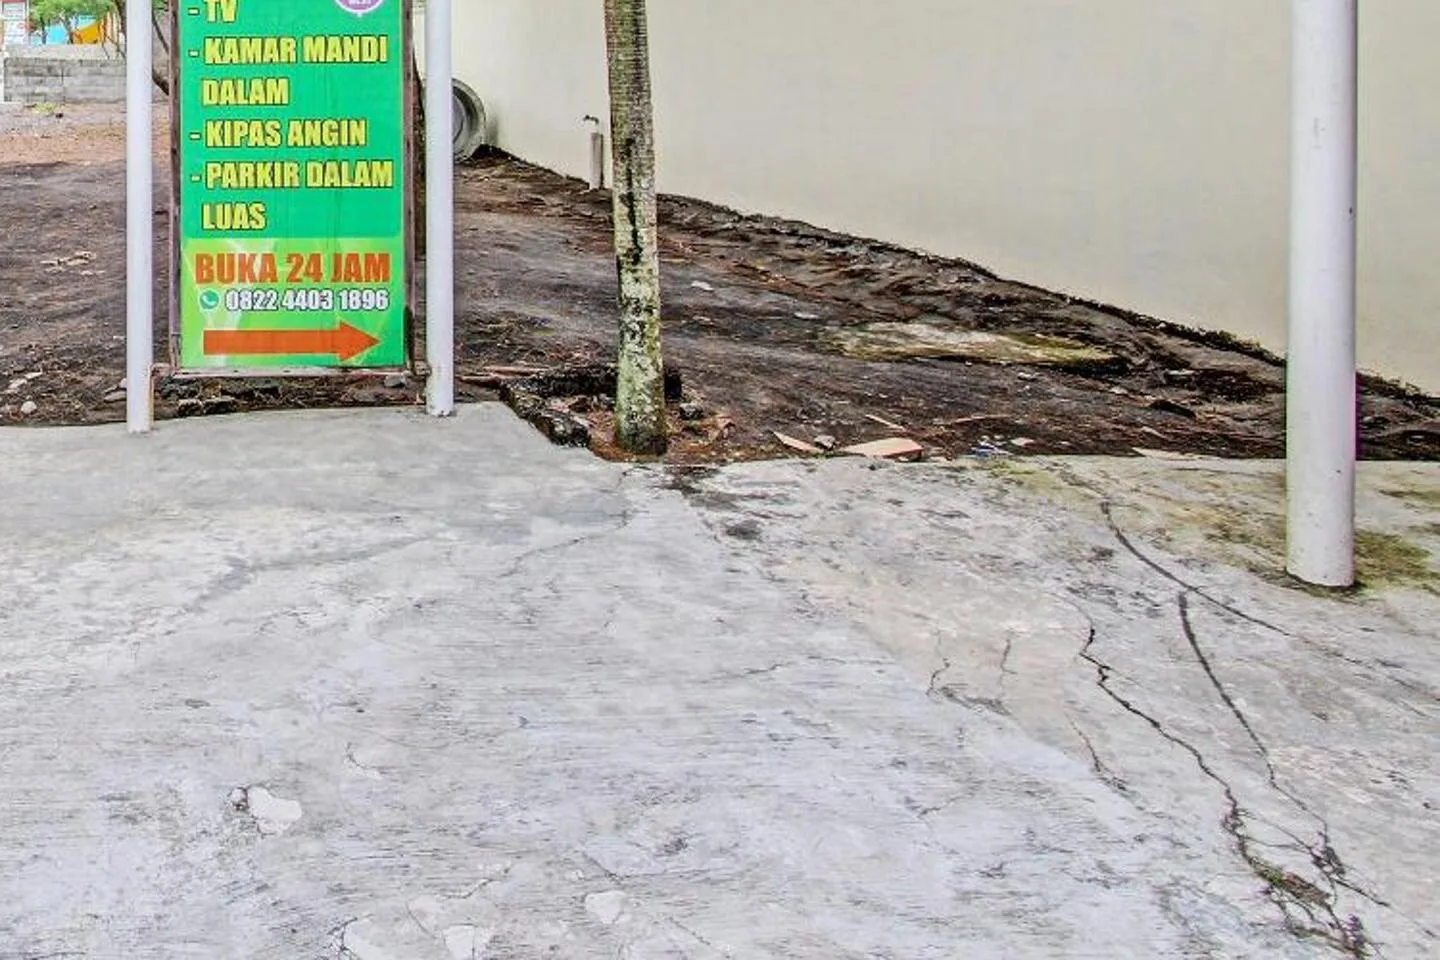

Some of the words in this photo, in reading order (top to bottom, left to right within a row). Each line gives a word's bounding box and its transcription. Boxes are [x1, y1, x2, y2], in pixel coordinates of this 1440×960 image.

[204, 37, 296, 64] KAMAR
[303, 35, 388, 63] MANDI
[201, 78, 289, 106] DALAM
[205, 120, 281, 147] KIPAS
[287, 119, 367, 146] ANGIN
[205, 162, 300, 189] PARKIR
[306, 160, 394, 188] DALAM
[201, 203, 267, 231] LUAS
[195, 253, 279, 285] BUKA
[286, 253, 323, 284] 24
[330, 253, 391, 283] JAM
[225, 289, 279, 311] 0822
[282, 289, 334, 311] 4403
[338, 289, 390, 310] 1896
